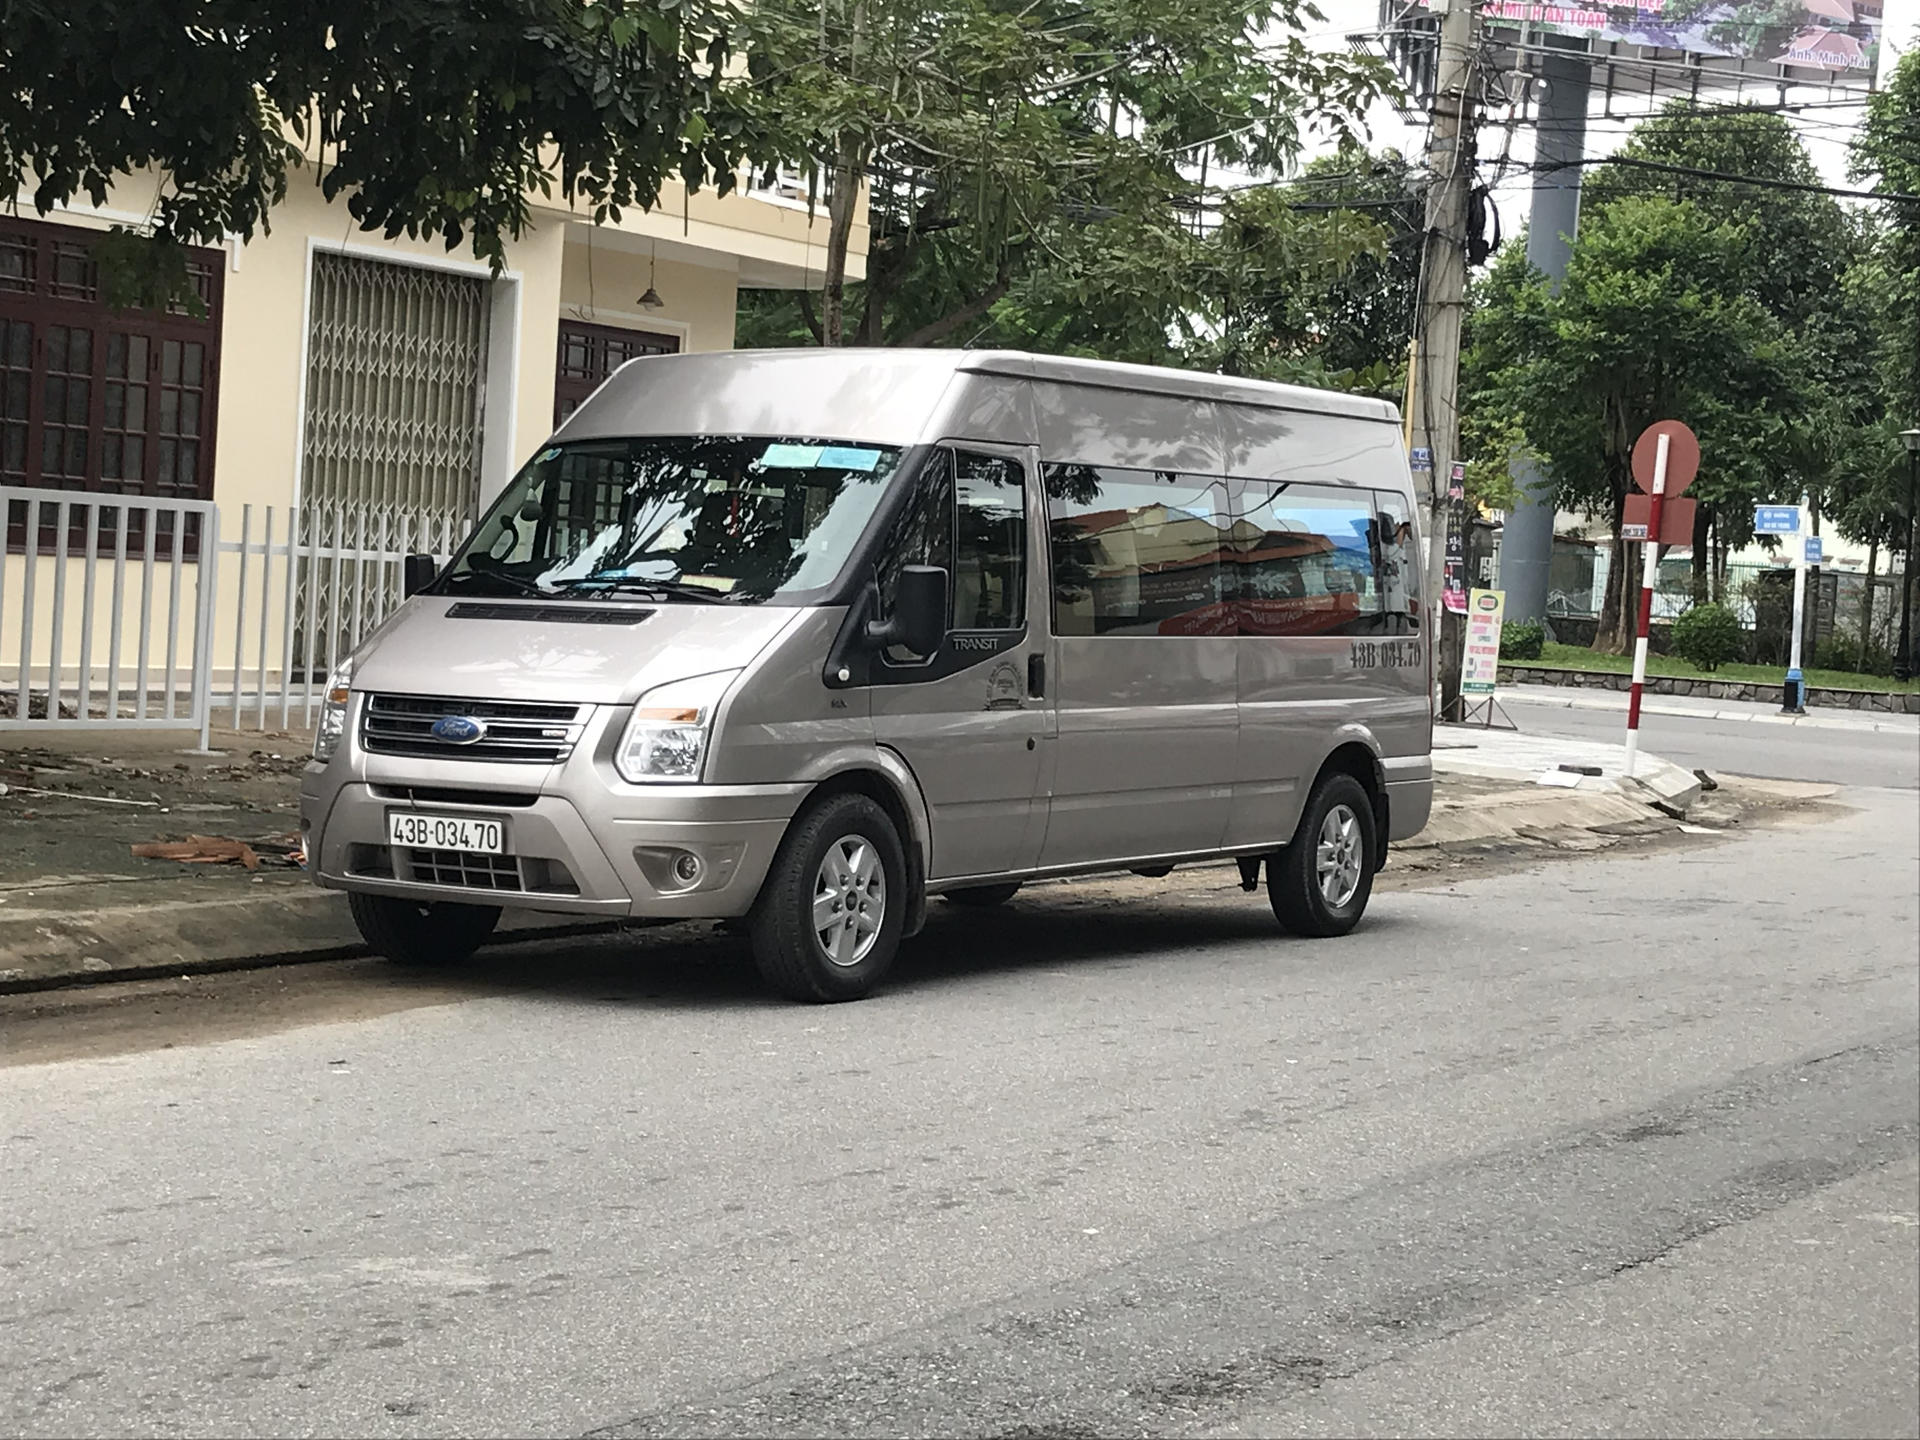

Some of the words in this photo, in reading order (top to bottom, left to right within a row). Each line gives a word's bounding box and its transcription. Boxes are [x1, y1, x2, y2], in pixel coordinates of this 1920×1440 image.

[952, 638, 999, 651] TRANSIT
[439, 720, 472, 737] Ford
[394, 817, 498, 850] 43B-034.70
